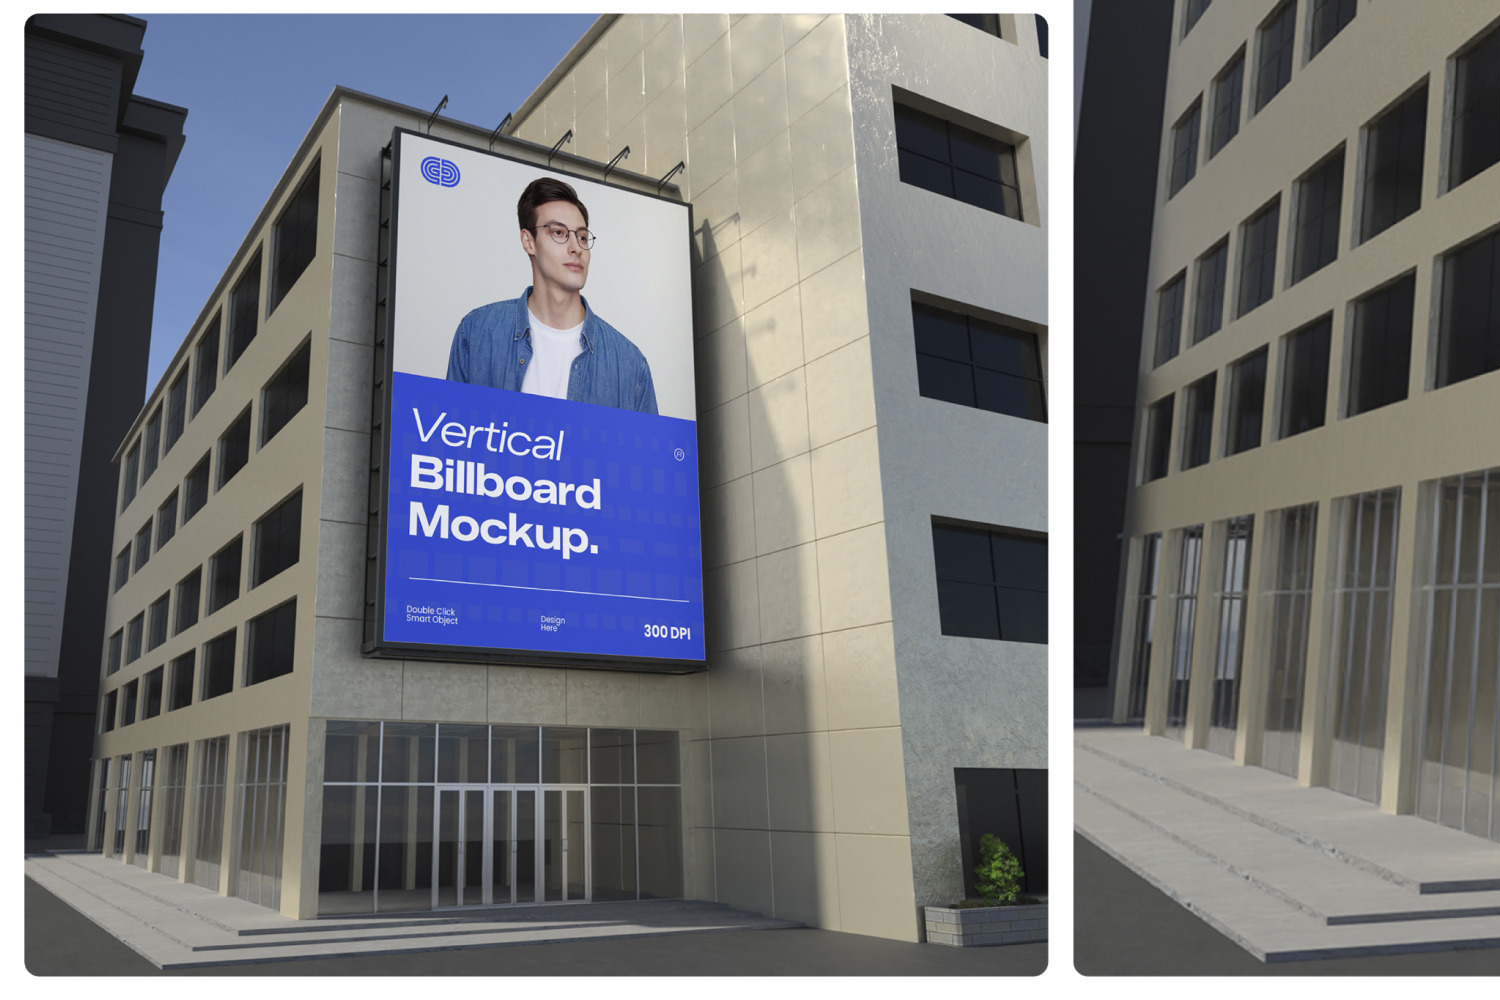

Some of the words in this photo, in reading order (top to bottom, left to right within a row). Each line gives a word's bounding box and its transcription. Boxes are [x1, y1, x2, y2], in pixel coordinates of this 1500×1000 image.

[412, 407, 565, 462] Vertical
[410, 453, 602, 511] Billboard
[408, 500, 599, 560] Mockup.
[406, 604, 435, 616] Double
[436, 607, 456, 617] Click
[406, 613, 431, 624] Smart
[432, 615, 459, 627] Object
[540, 615, 566, 627] Design
[540, 623, 558, 633] Here
[643, 623, 669, 639] 300
[670, 626, 691, 641] DPI
